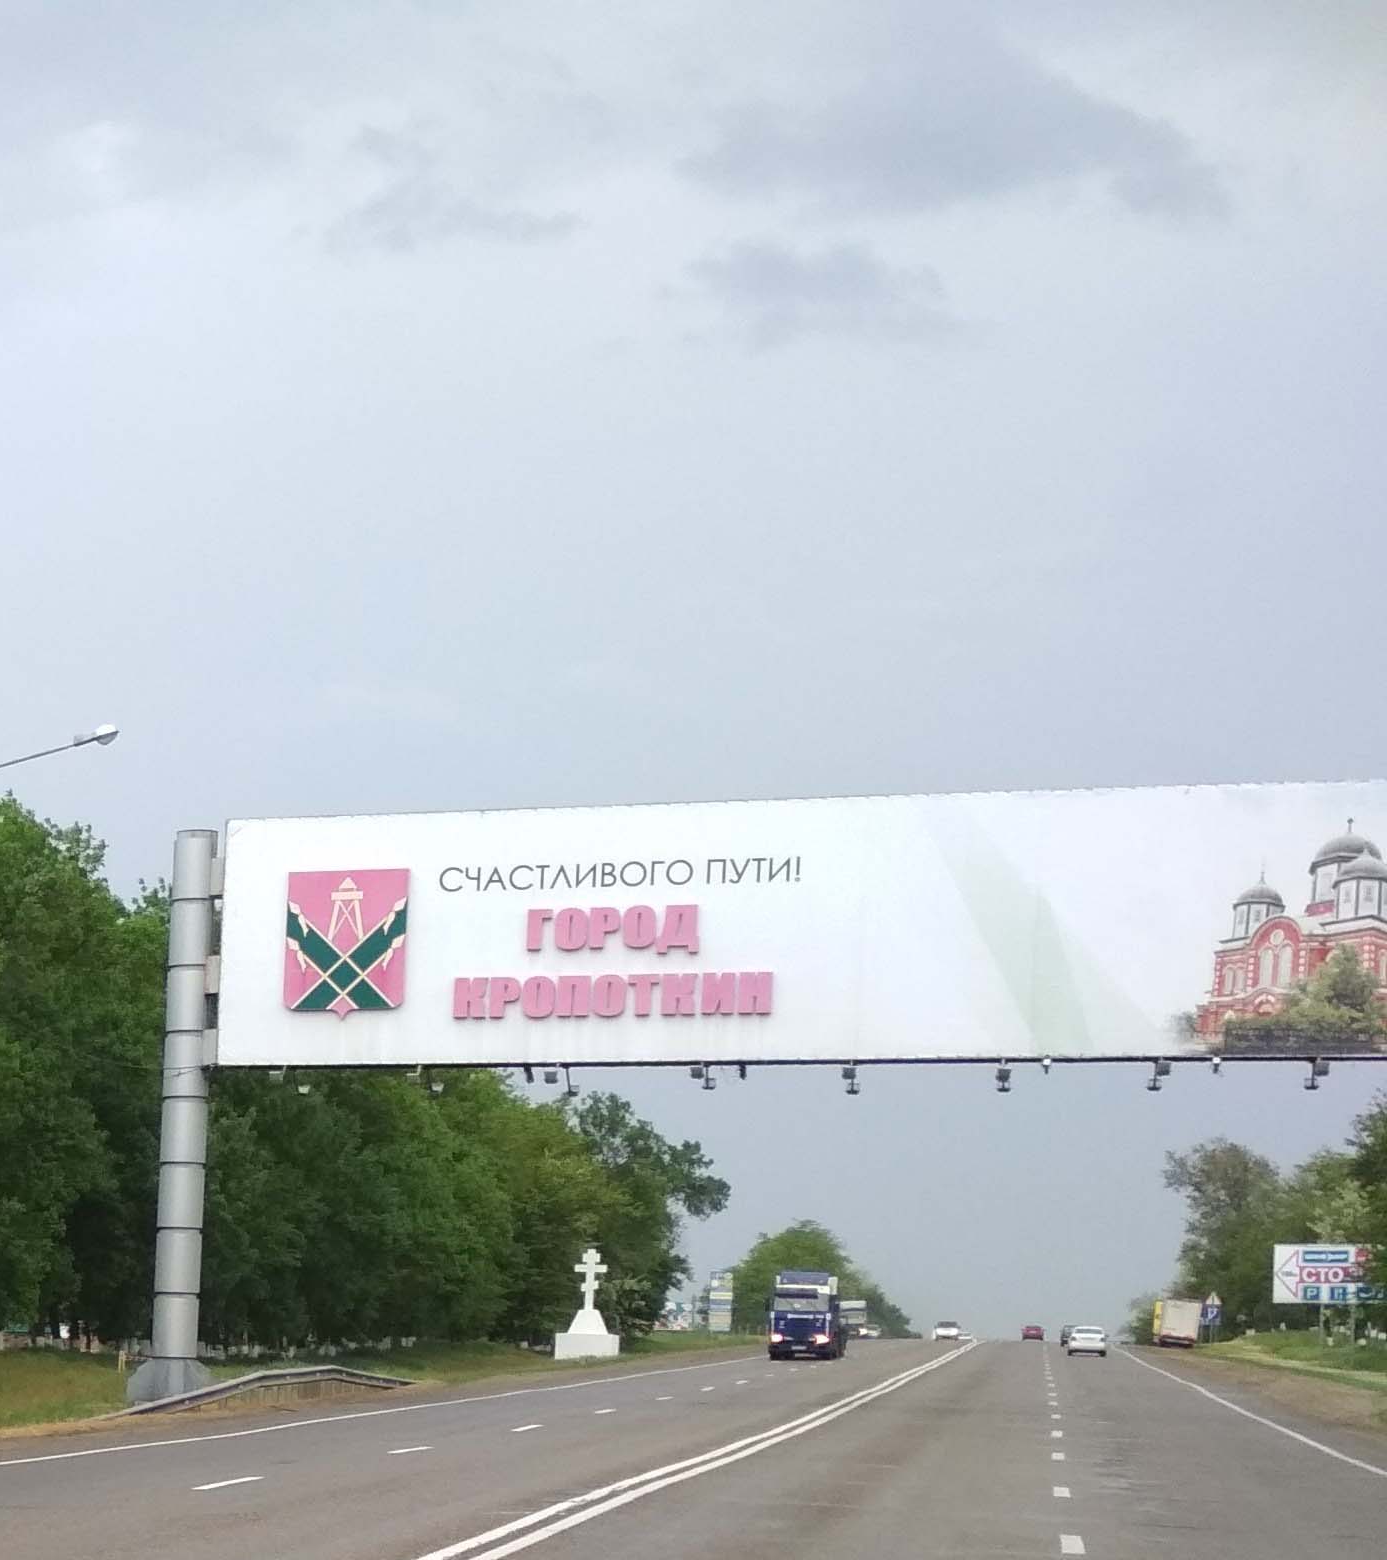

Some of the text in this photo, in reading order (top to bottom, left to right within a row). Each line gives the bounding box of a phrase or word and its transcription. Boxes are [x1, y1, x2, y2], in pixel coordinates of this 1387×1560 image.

[439, 856, 802, 892] СЧАСТЛИВОГО ПУТИ!
[527, 904, 699, 955] ГОРОД
[452, 971, 774, 1020] КРОПОТКИН
